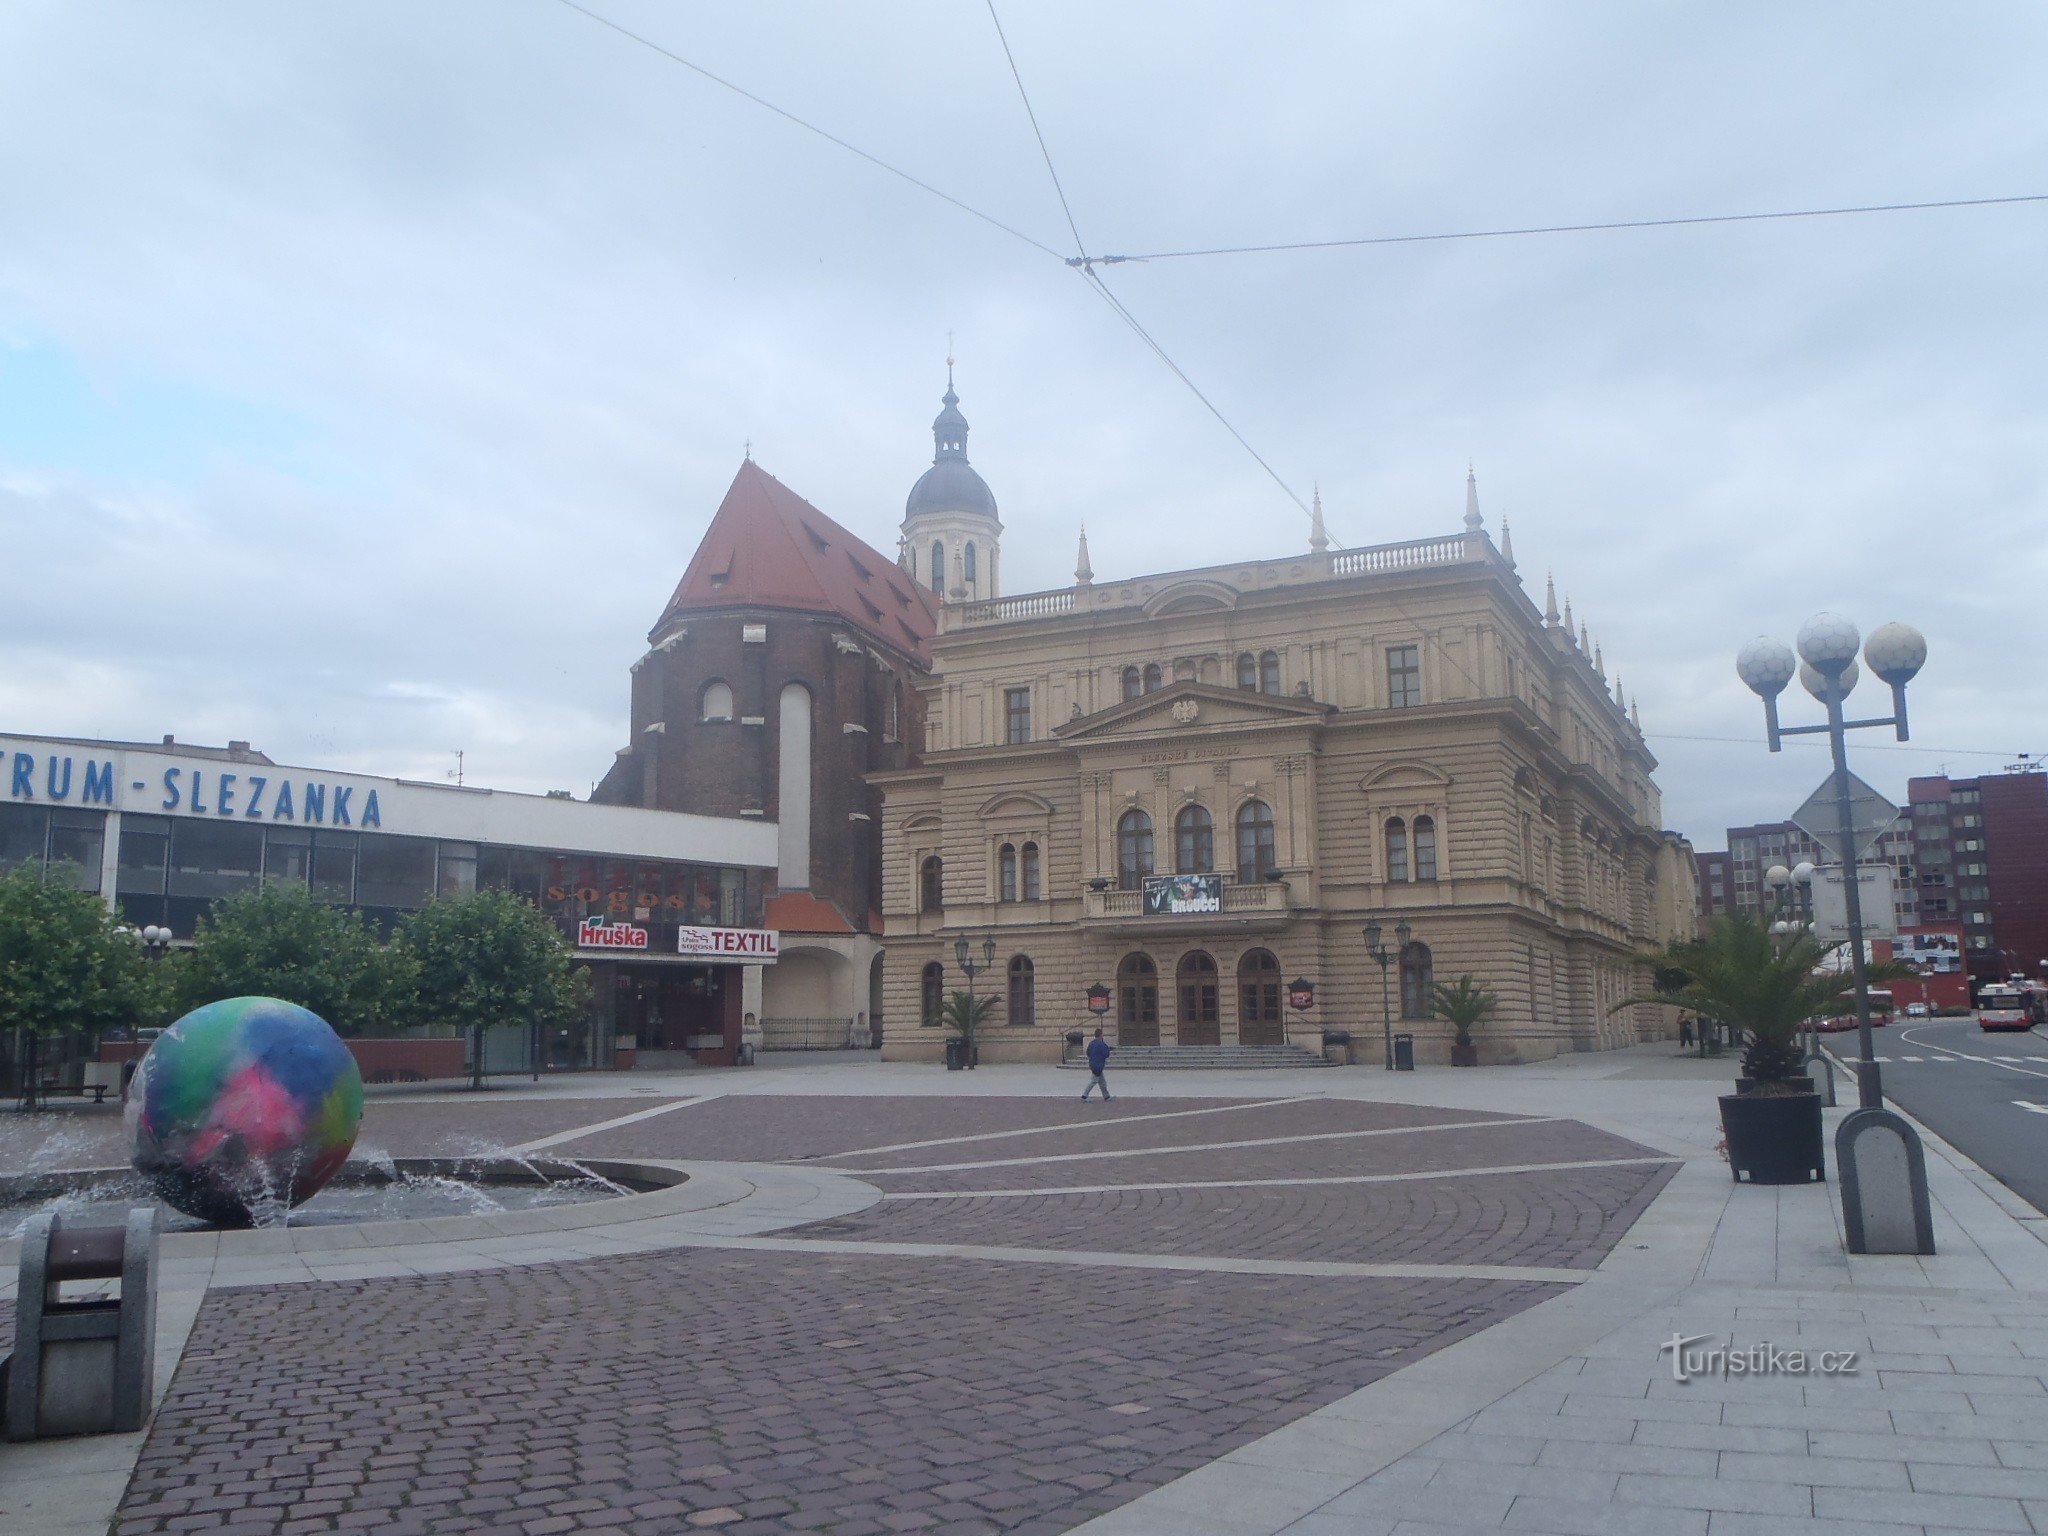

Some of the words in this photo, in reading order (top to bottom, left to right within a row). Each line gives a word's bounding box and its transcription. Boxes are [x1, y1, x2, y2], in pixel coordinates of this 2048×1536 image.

[2003, 763, 2044, 771] HOTEL
[0, 750, 114, 803] RUM
[162, 767, 381, 828] SLEZANKA
[580, 923, 646, 946] Hruška
[711, 931, 777, 953] TEXTIL
[681, 943, 714, 952] sogoss
